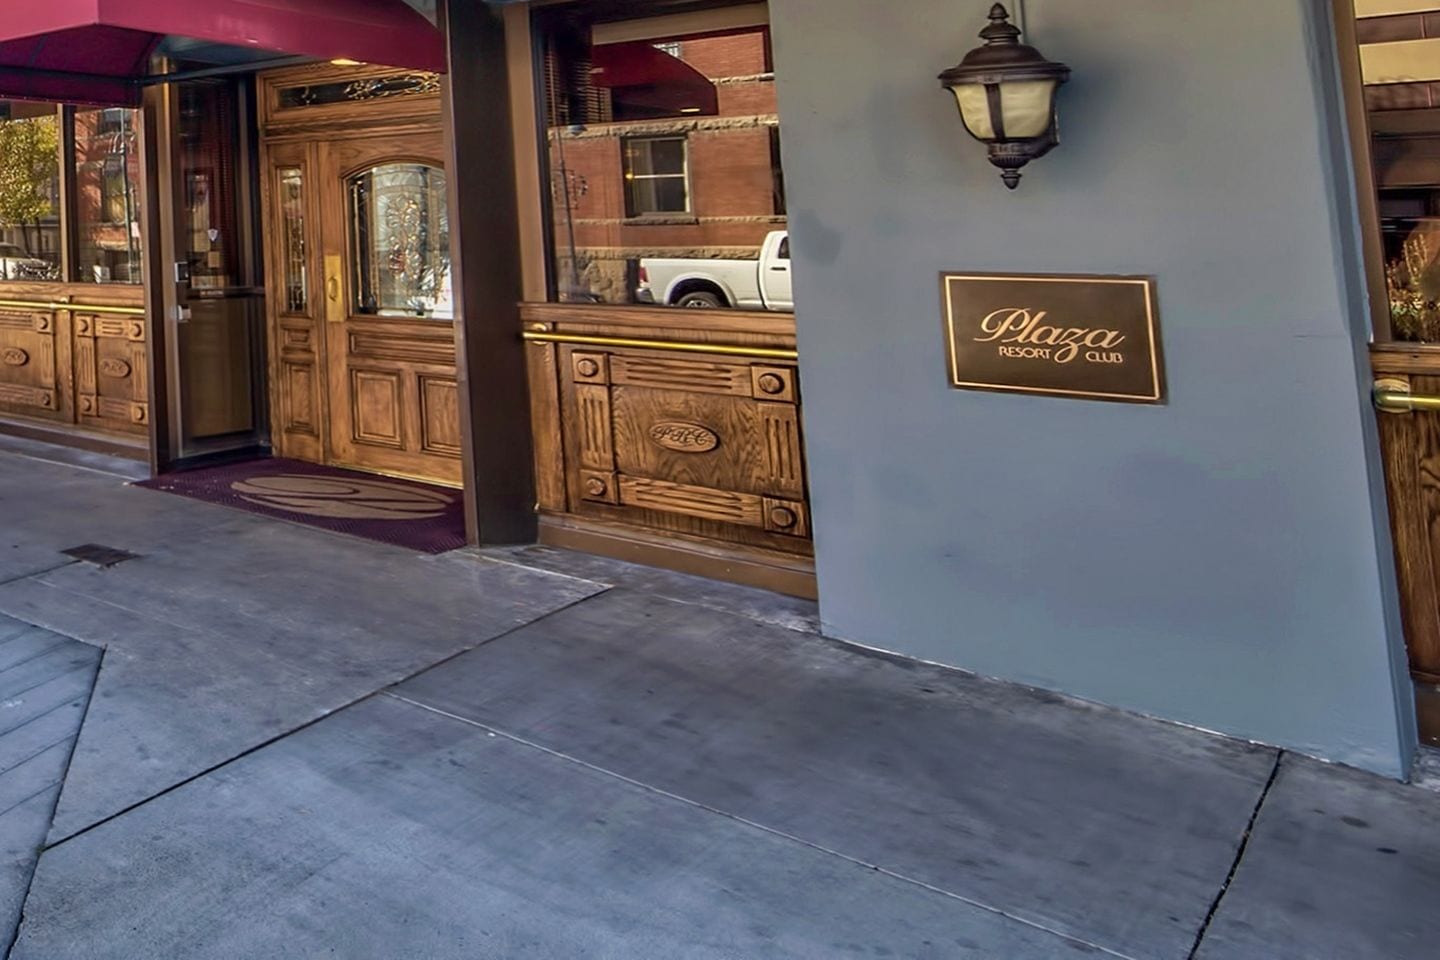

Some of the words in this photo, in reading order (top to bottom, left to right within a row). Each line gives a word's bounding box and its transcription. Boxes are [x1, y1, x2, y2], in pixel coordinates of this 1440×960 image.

[973, 307, 1125, 364] Plaza
[999, 345, 1051, 360] RESORT
[1085, 350, 1124, 363] CLUB
